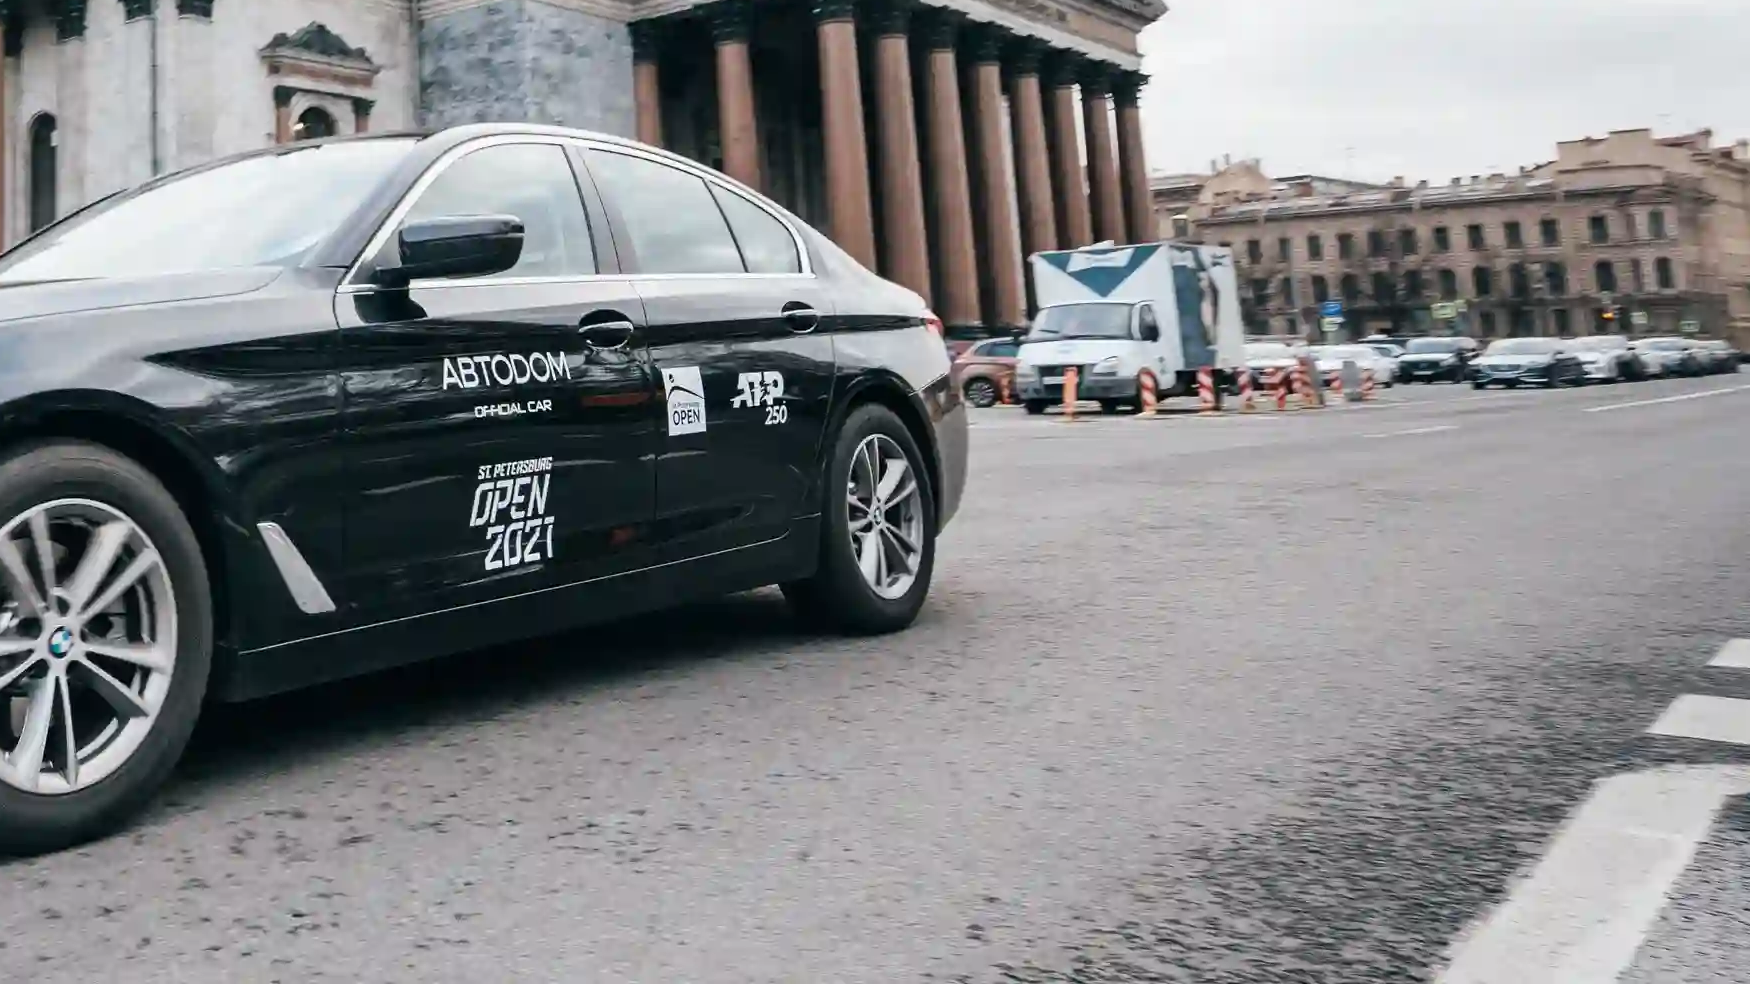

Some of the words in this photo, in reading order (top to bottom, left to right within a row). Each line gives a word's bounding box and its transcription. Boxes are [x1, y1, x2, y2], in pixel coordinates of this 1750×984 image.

[527, 399, 552, 413] CAR
[765, 404, 788, 425] 250
[673, 409, 700, 425] OPEN
[494, 457, 552, 478] PETERSBURG
[470, 474, 550, 526] OPEN
[485, 516, 555, 570] 2021
